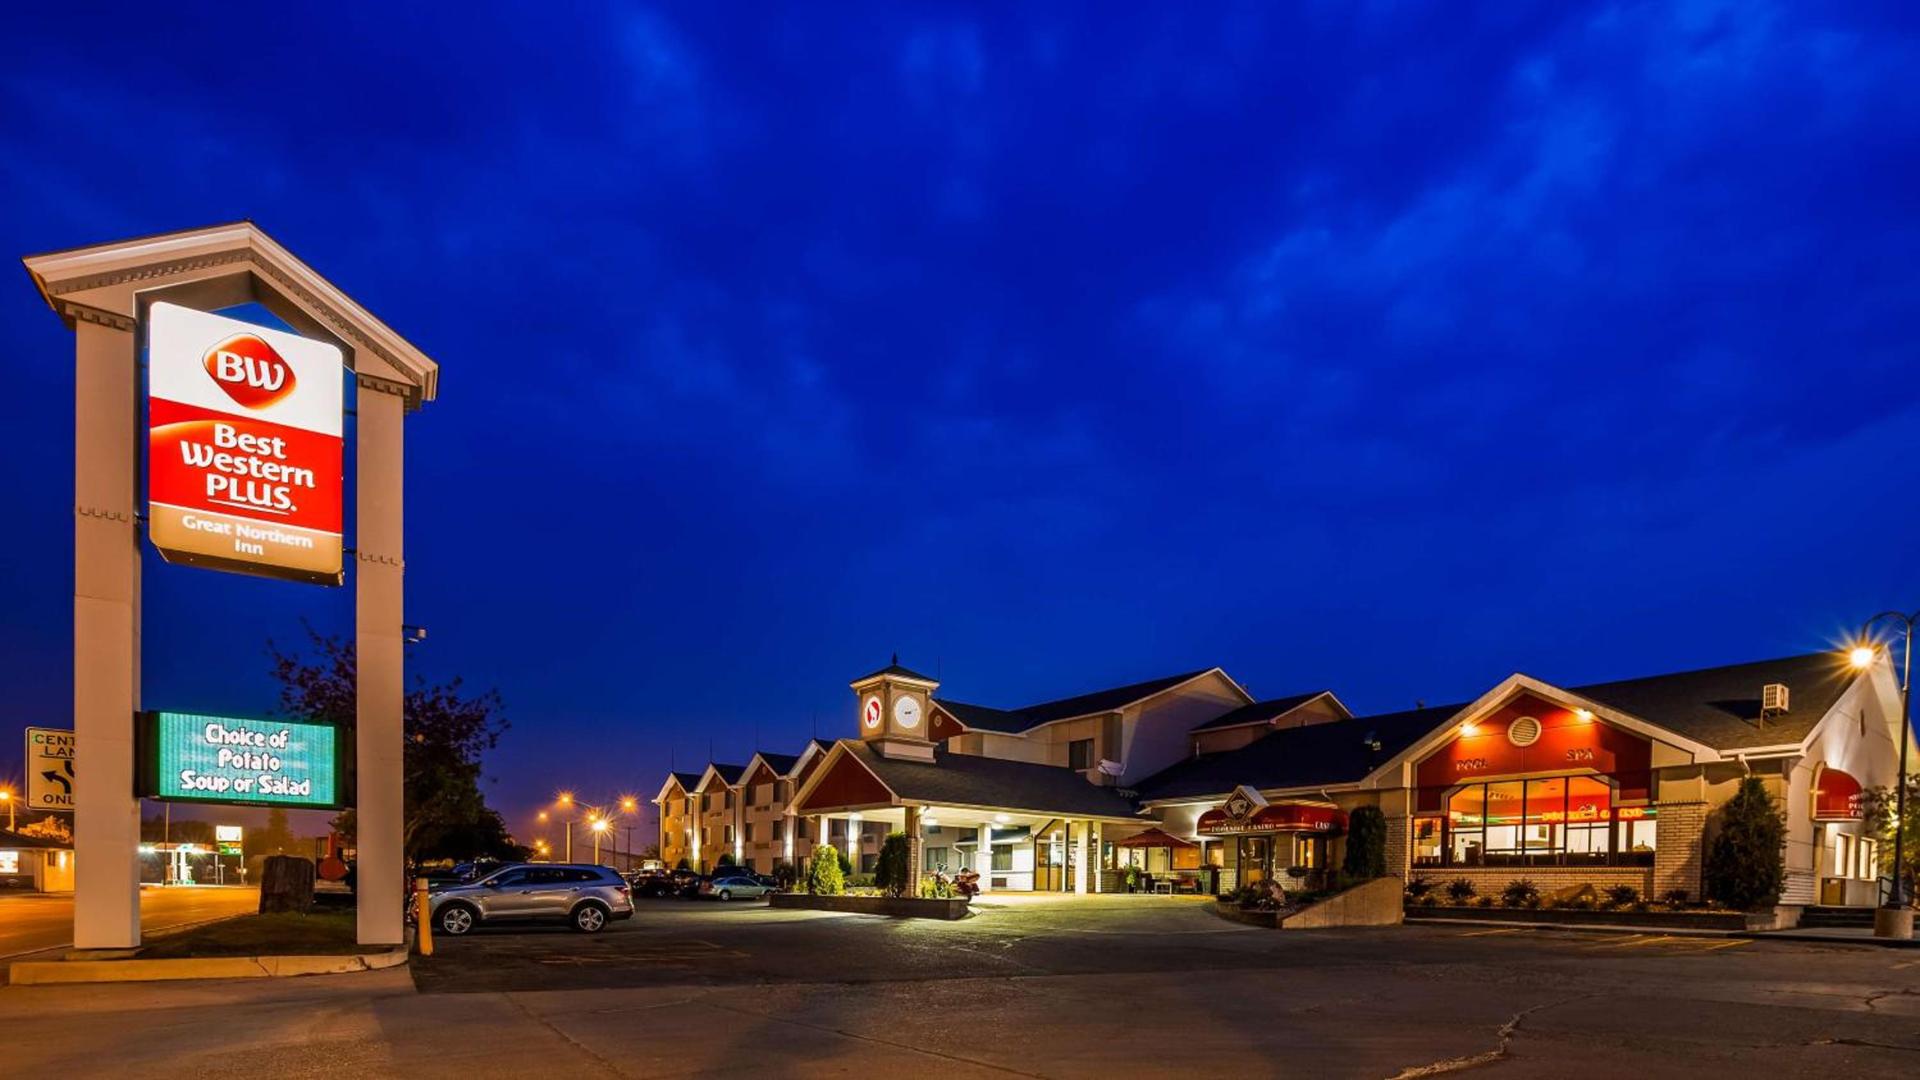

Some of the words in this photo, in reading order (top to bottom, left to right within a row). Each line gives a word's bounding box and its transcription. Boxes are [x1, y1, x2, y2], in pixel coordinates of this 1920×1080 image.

[217, 351, 285, 391] BW
[214, 423, 286, 459] Best
[179, 439, 316, 489] Western
[181, 515, 233, 536] Great
[233, 522, 314, 549] Northern
[234, 538, 265, 556] Inn
[34, 733, 76, 747] CENT
[204, 722, 266, 748] Choice
[268, 730, 290, 749] of
[217, 748, 281, 772] Potato
[1566, 748, 1594, 761] SPA
[180, 768, 231, 794] Soup
[232, 777, 255, 793] or
[257, 774, 312, 797] Salad
[42, 793, 75, 806] ONL
